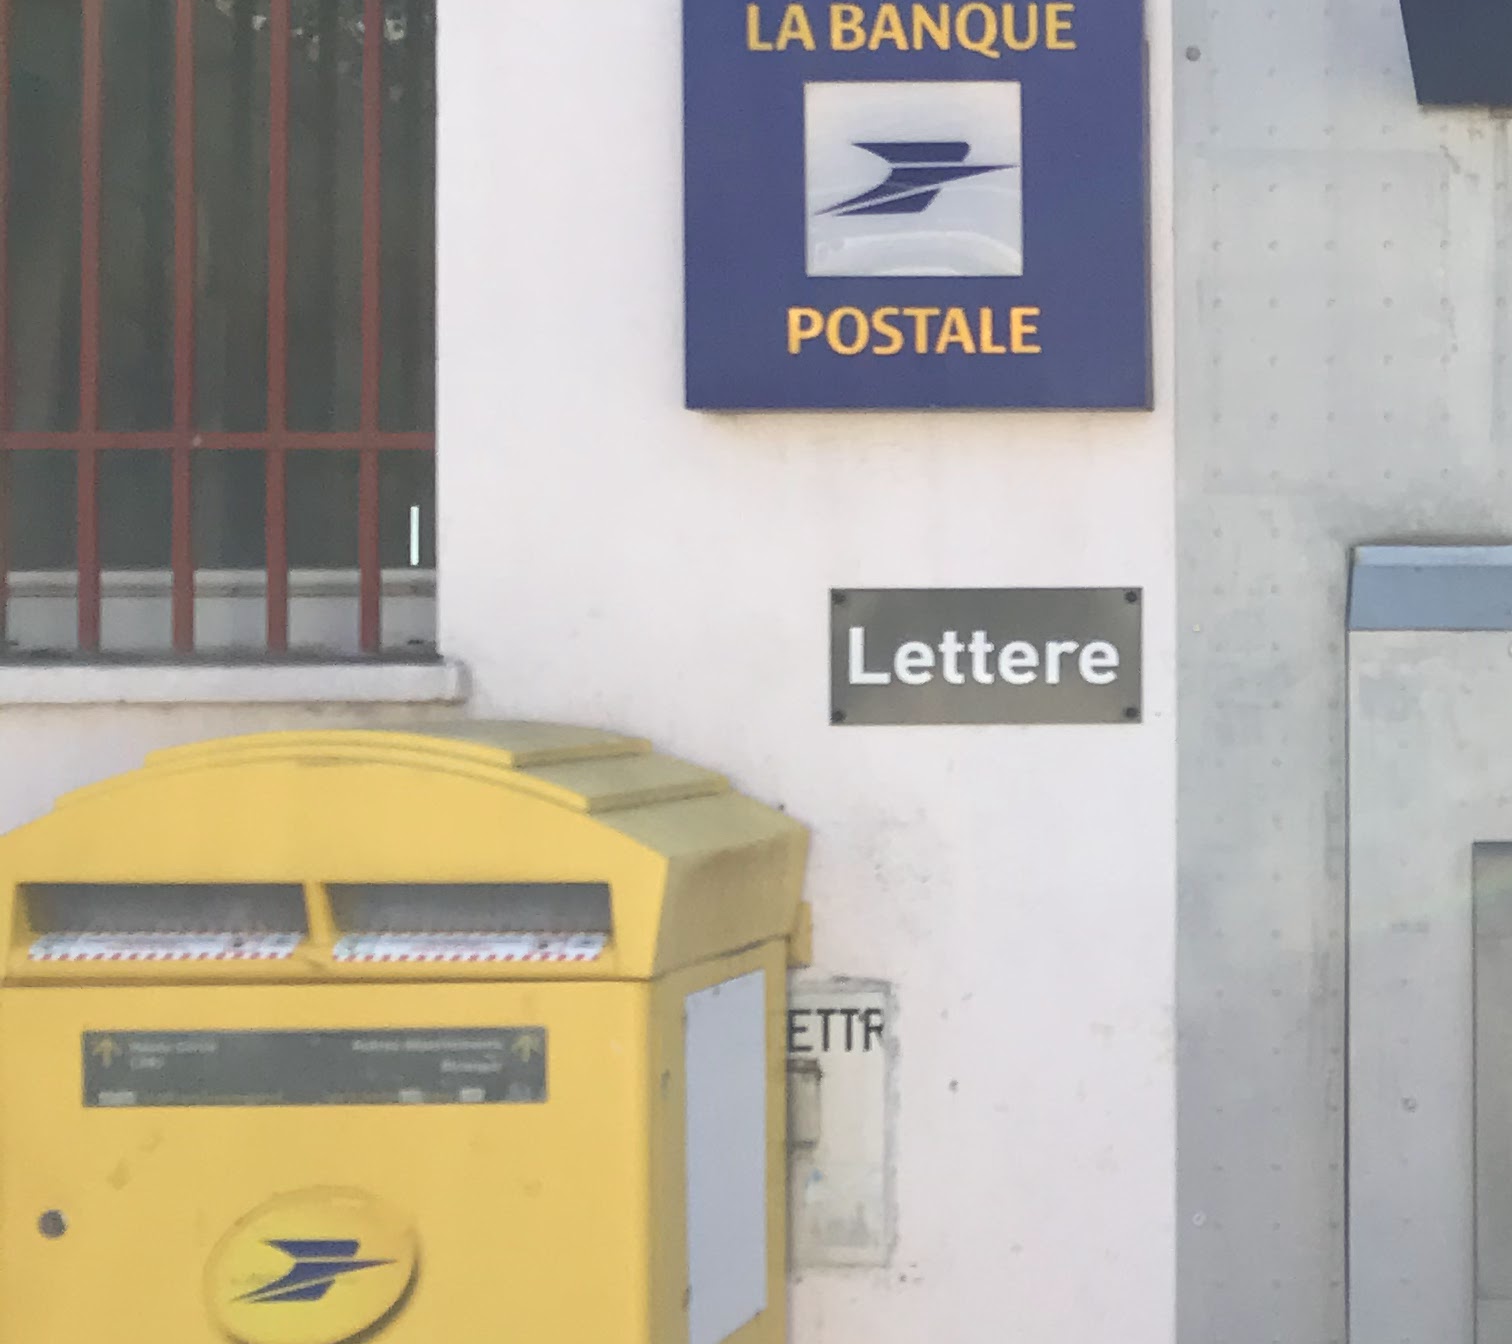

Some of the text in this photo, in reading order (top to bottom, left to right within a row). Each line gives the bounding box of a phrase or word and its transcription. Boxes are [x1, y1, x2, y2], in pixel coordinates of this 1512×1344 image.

[745, 2, 1077, 58] LA BANQUE
[787, 306, 1043, 356] POSTALE
[848, 626, 1121, 687] Lettere
